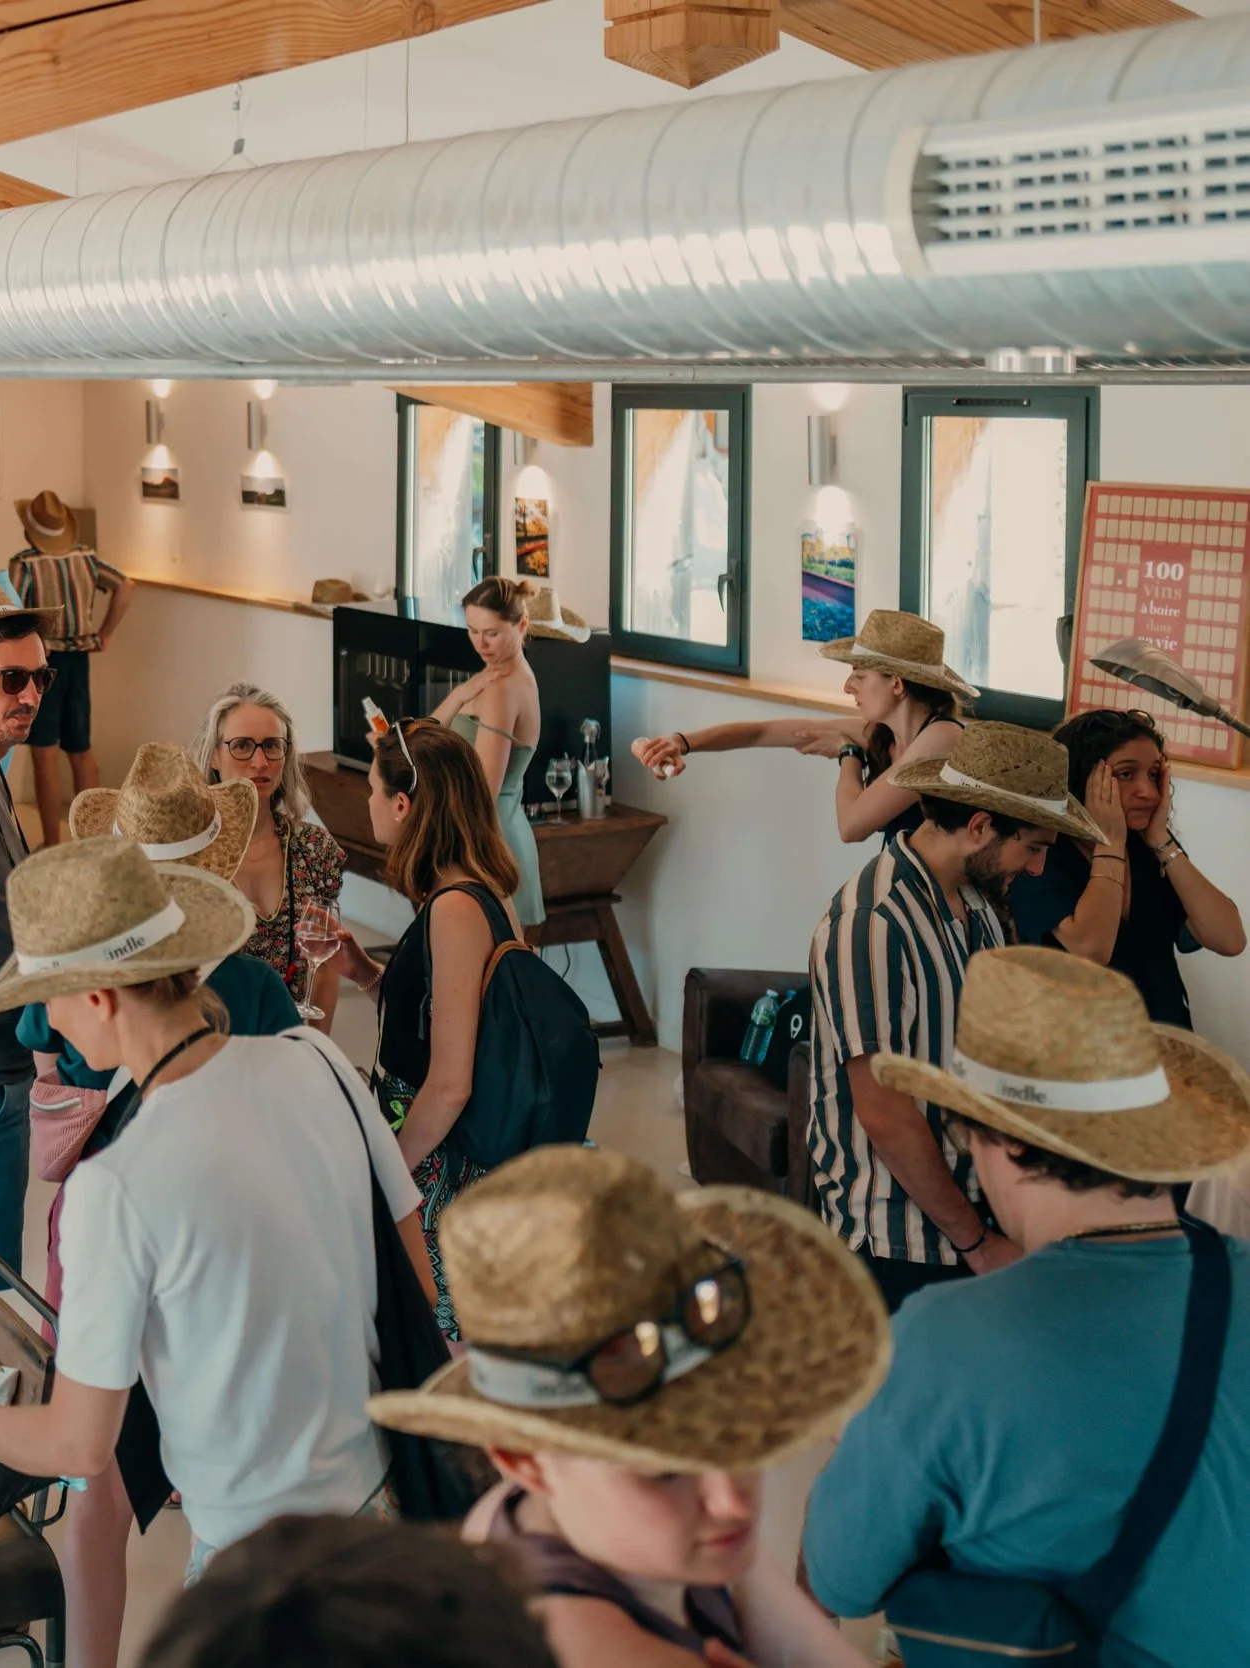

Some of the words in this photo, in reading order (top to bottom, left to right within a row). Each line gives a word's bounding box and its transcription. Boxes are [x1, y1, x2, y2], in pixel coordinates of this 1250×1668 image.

[1144, 561, 1184, 580] 100
[1144, 580, 1182, 599] vins
[1140, 601, 1148, 615] à
[1149, 600, 1181, 618] boire
[1146, 618, 1172, 633] dans
[1155, 636, 1179, 652] vie
